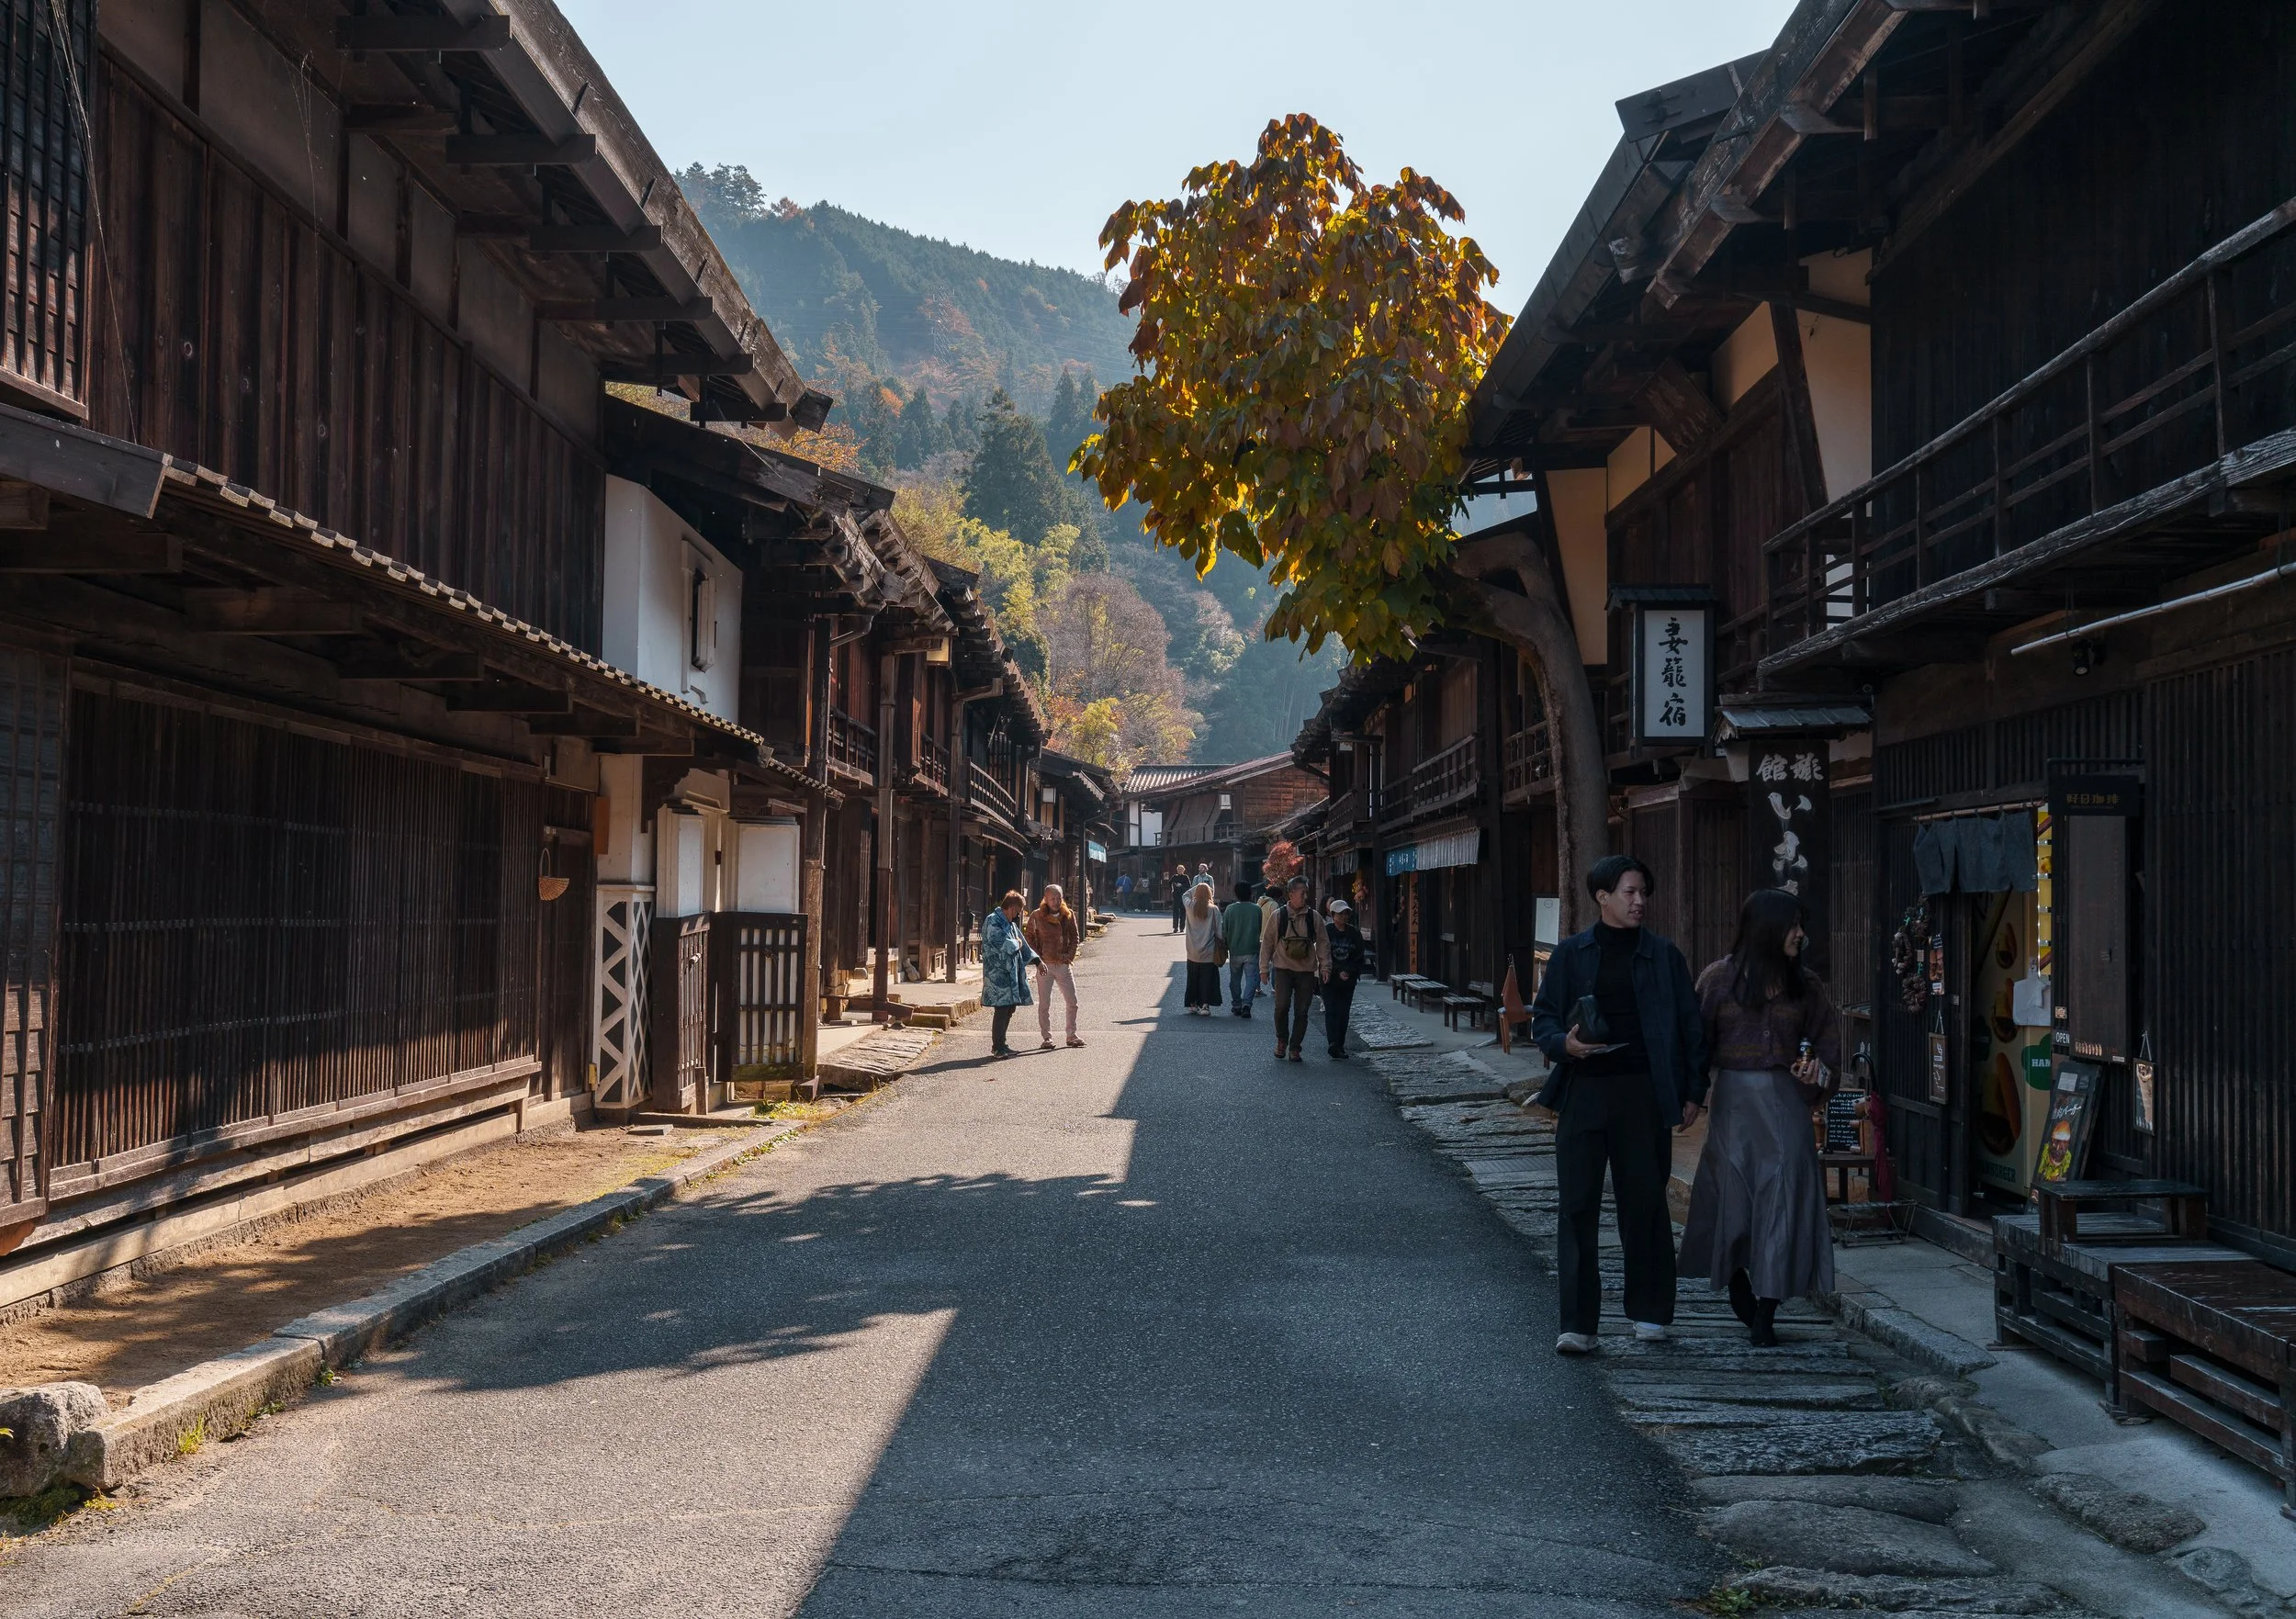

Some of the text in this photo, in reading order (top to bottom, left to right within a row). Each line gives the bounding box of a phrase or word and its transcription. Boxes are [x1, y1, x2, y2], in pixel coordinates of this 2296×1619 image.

[1659, 617, 1688, 726] 妻籠宿
[2055, 1031, 2070, 1044] OPEN
[1978, 1159, 2016, 1183] MBURGER
